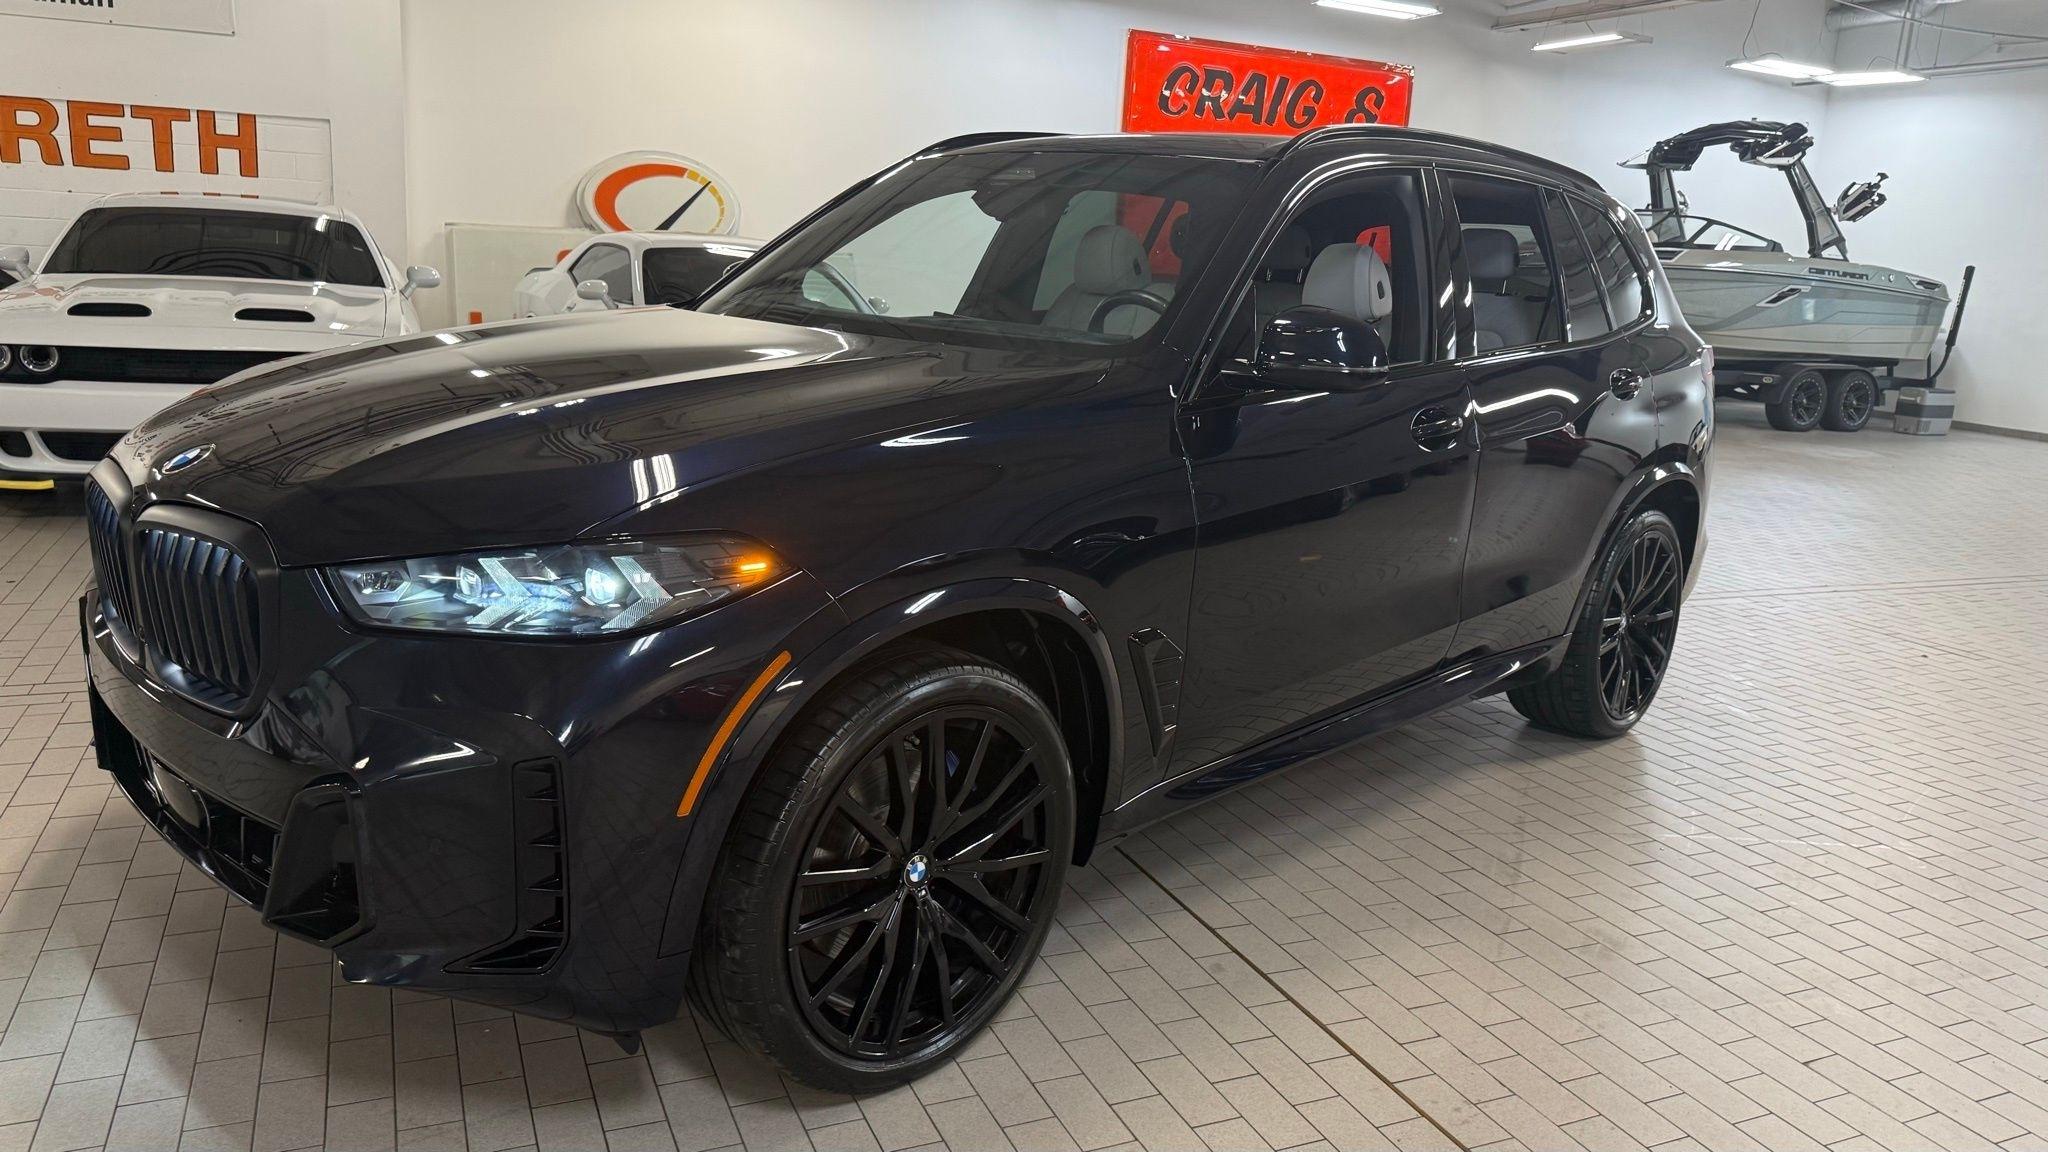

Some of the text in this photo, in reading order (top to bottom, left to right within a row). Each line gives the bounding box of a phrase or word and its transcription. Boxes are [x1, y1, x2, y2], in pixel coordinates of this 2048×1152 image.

[1159, 64, 1324, 128] CRAIG
[0, 95, 259, 177] RETH
[1808, 267, 1869, 281] CENTURION
